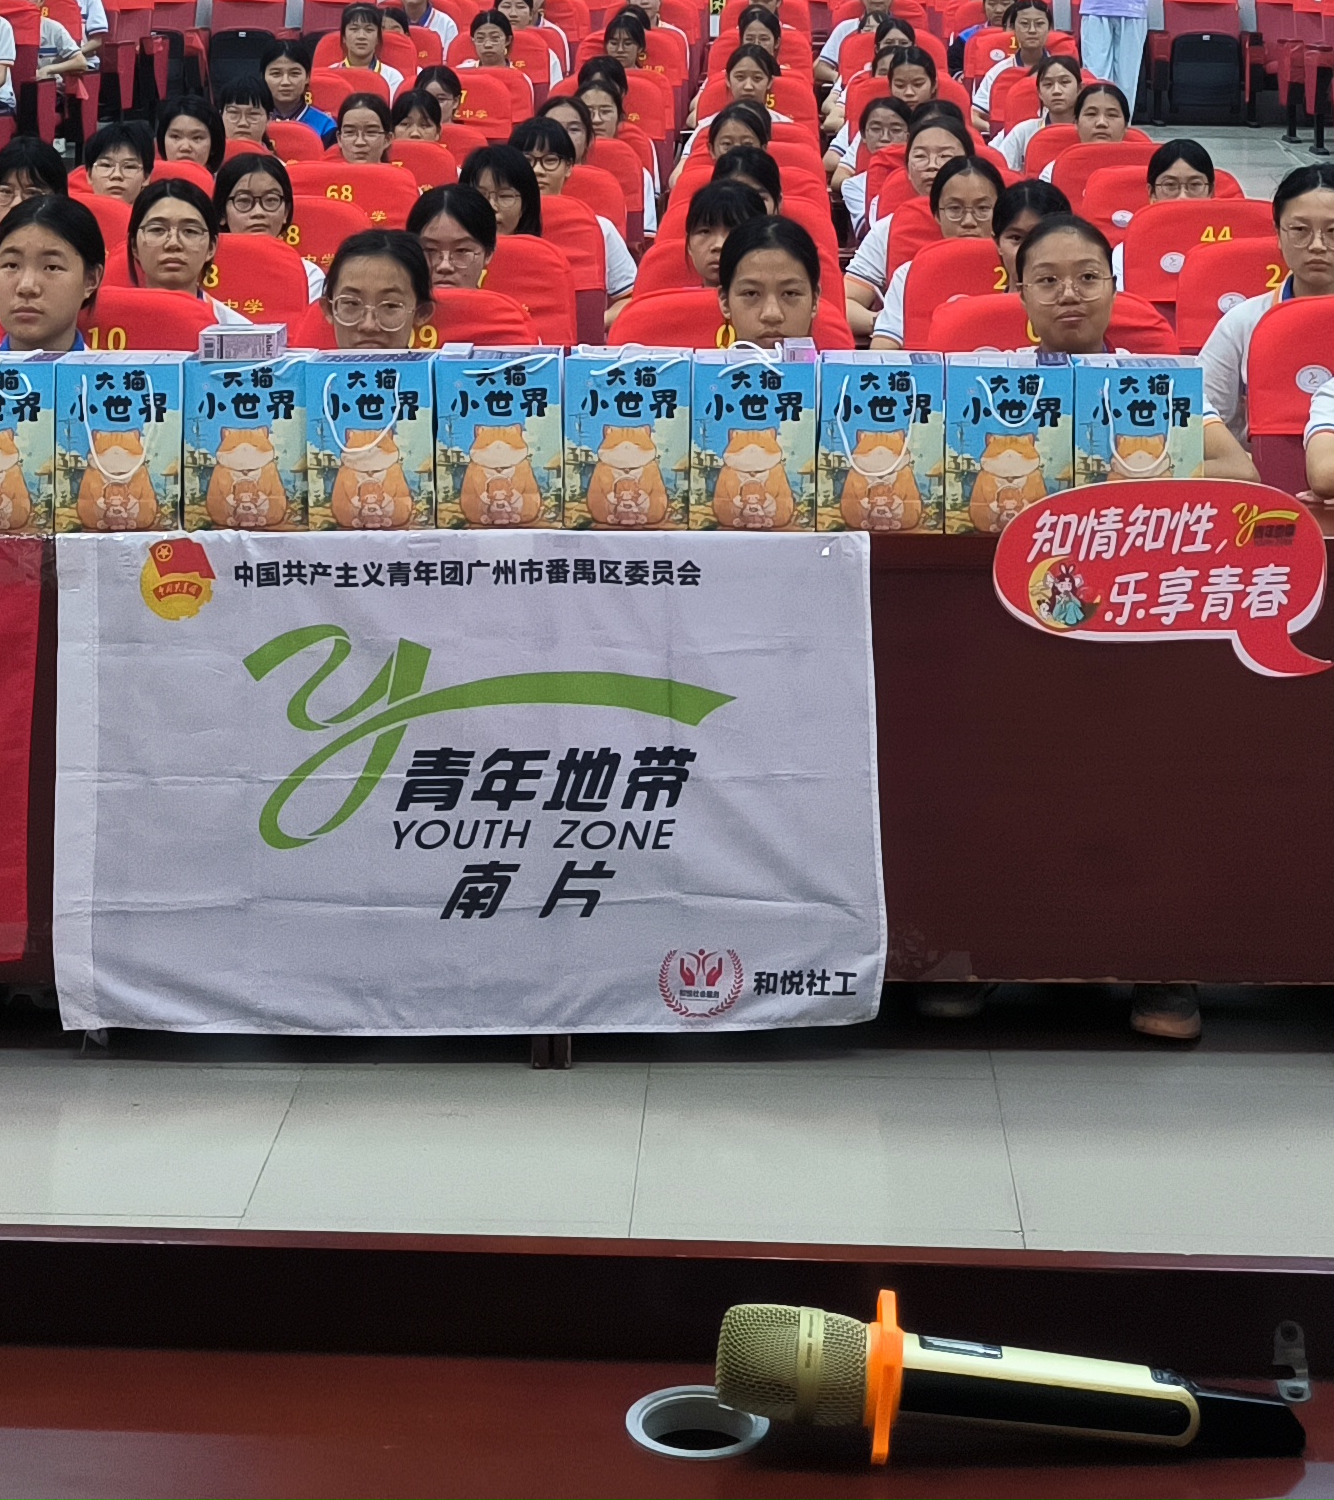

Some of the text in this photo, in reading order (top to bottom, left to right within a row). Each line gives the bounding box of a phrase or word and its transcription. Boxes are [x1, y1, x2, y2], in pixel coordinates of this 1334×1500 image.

[326, 184, 353, 203] 68
[1200, 226, 1233, 242] 44
[88, 326, 126, 351] 10
[94, 368, 147, 391] 大猫
[347, 367, 397, 390] 大猫
[606, 366, 657, 388] 大猫
[730, 369, 782, 390] 大猫
[859, 370, 911, 392] 大猫
[989, 374, 1041, 396] 大猫
[1118, 373, 1170, 396] 大猫
[70, 392, 167, 423] 小世界
[198, 390, 295, 421] 小世界
[322, 390, 420, 421] 小世界
[450, 388, 548, 419] 小世界
[581, 389, 678, 420] 小世界
[705, 391, 804, 422] 小世界
[833, 393, 932, 424] 小世界
[963, 397, 1063, 428] 小世界
[1092, 396, 1191, 428] 小世界
[233, 558, 703, 589] 中国共产主义青年团广州市番禺区委员会
[1104, 562, 1292, 626] 乐享青春
[395, 746, 697, 812] 青年地带
[392, 818, 676, 851] YOUTH ZONE
[752, 968, 858, 997] 和悦社工
